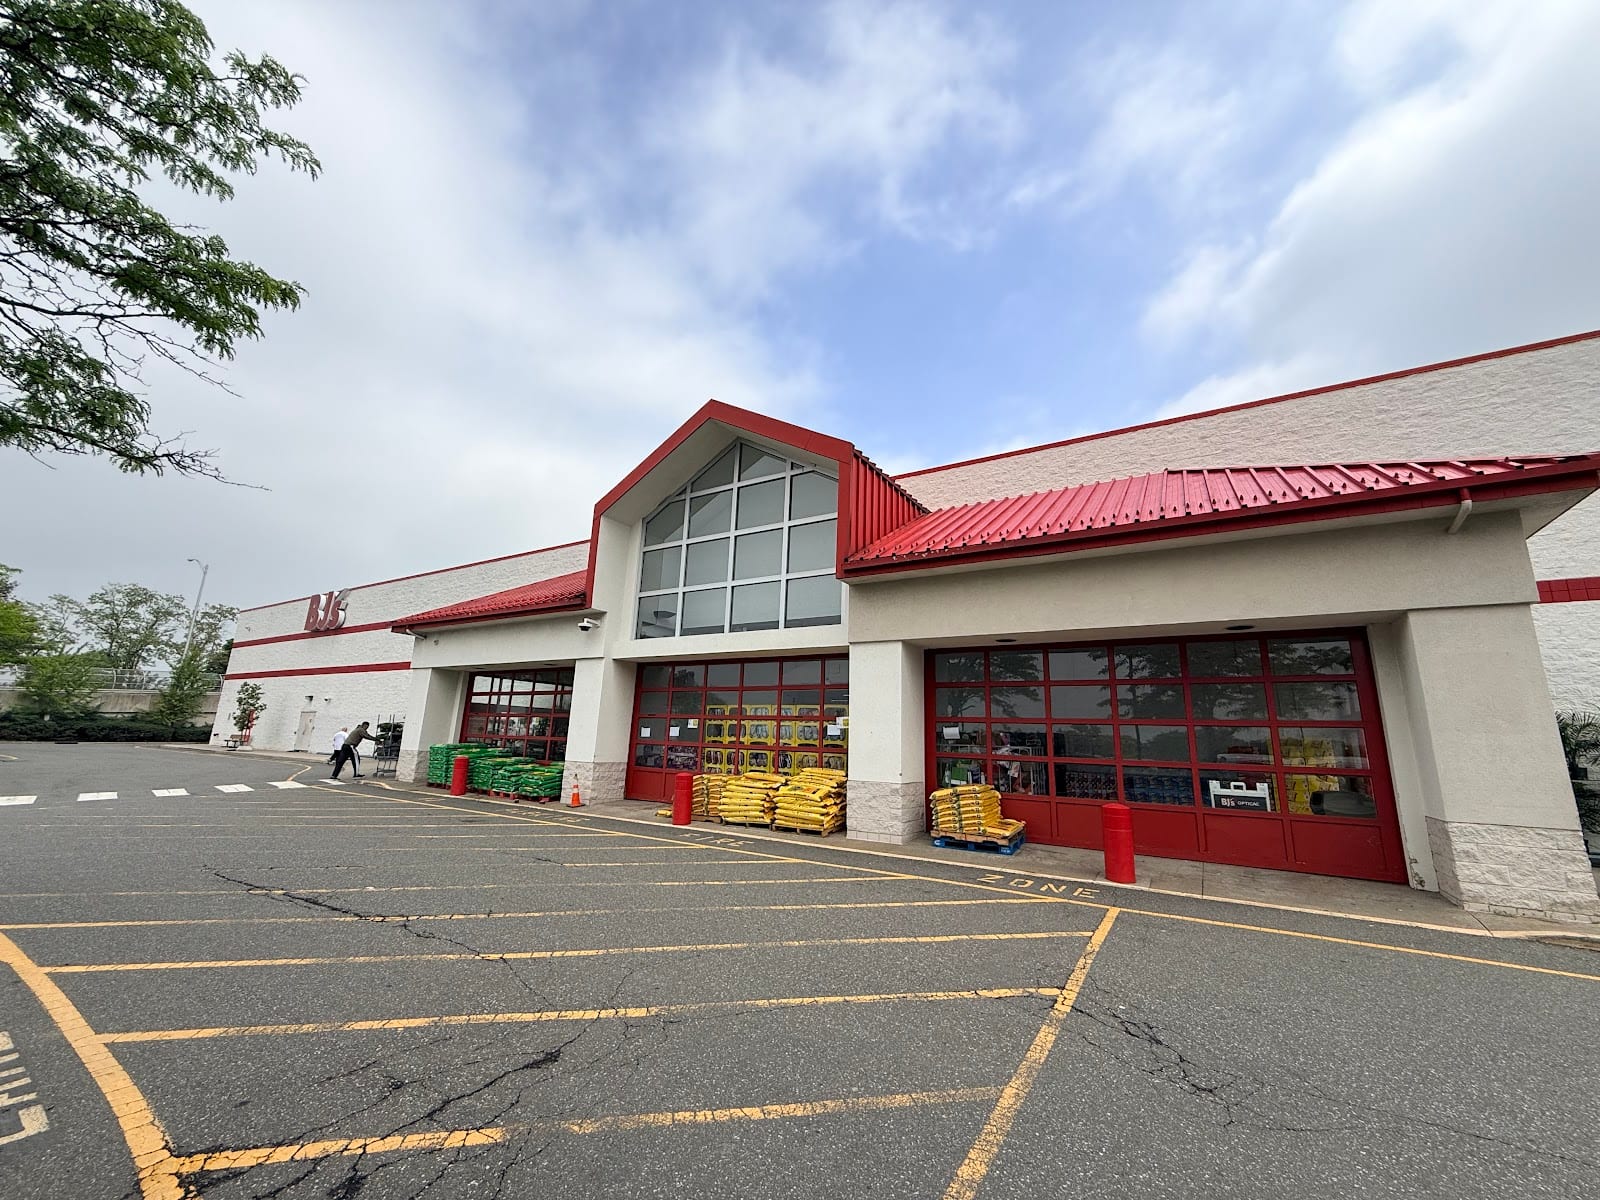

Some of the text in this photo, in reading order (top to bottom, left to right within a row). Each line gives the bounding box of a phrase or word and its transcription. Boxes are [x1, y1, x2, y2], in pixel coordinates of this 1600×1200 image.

[1221, 797, 1261, 808] BJ's OPTICAL
[679, 833, 1101, 899] FIRE ZONE
